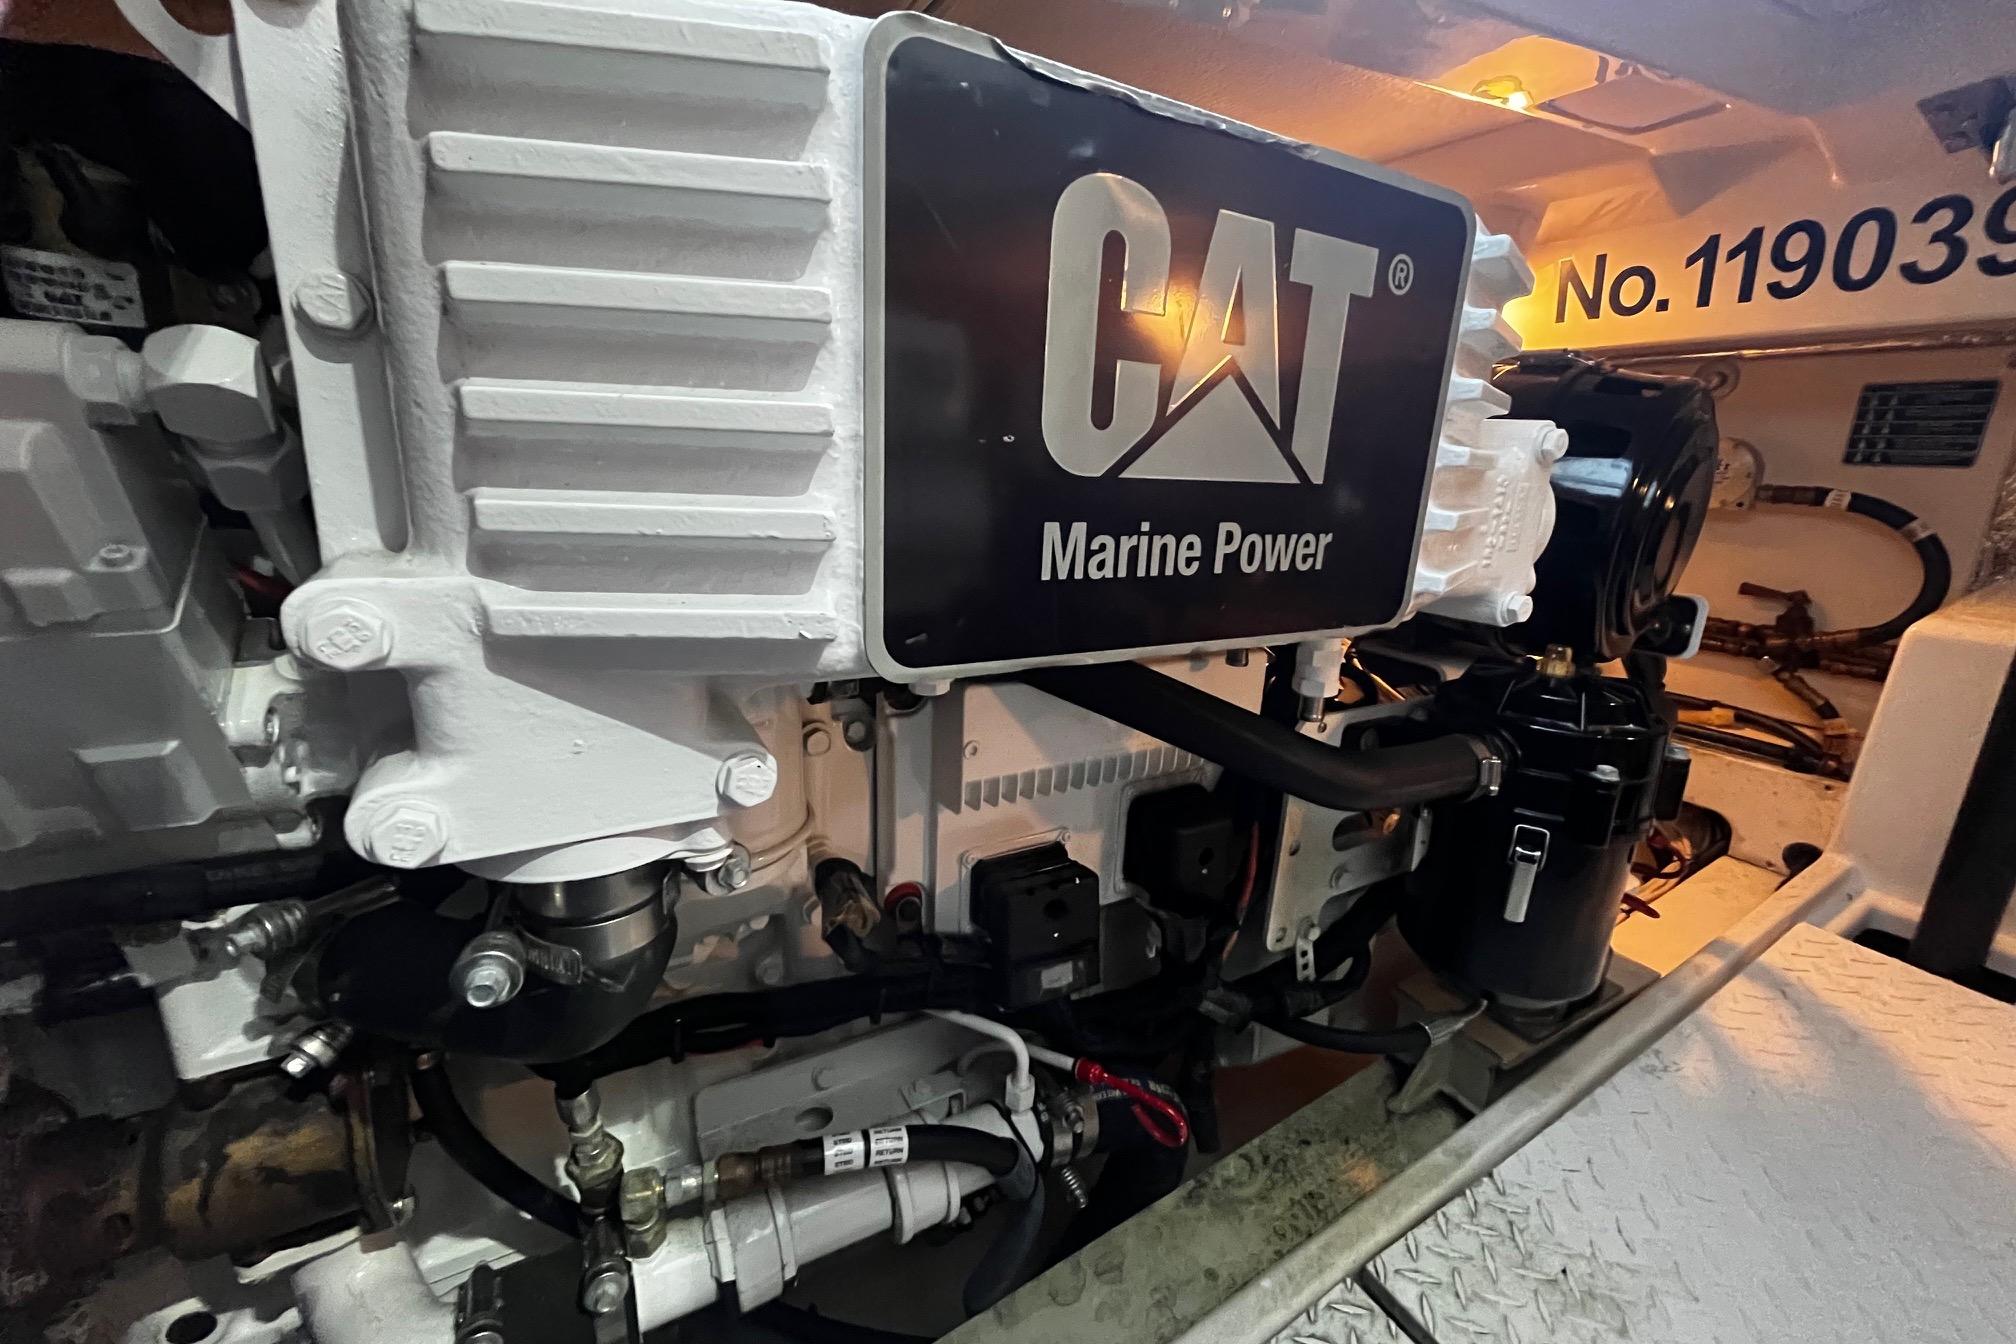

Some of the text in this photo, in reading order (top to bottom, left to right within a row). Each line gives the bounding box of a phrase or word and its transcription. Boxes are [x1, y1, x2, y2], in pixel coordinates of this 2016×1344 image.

[1041, 172, 1379, 485] CAT
[1041, 521, 1333, 581] Marine Power
